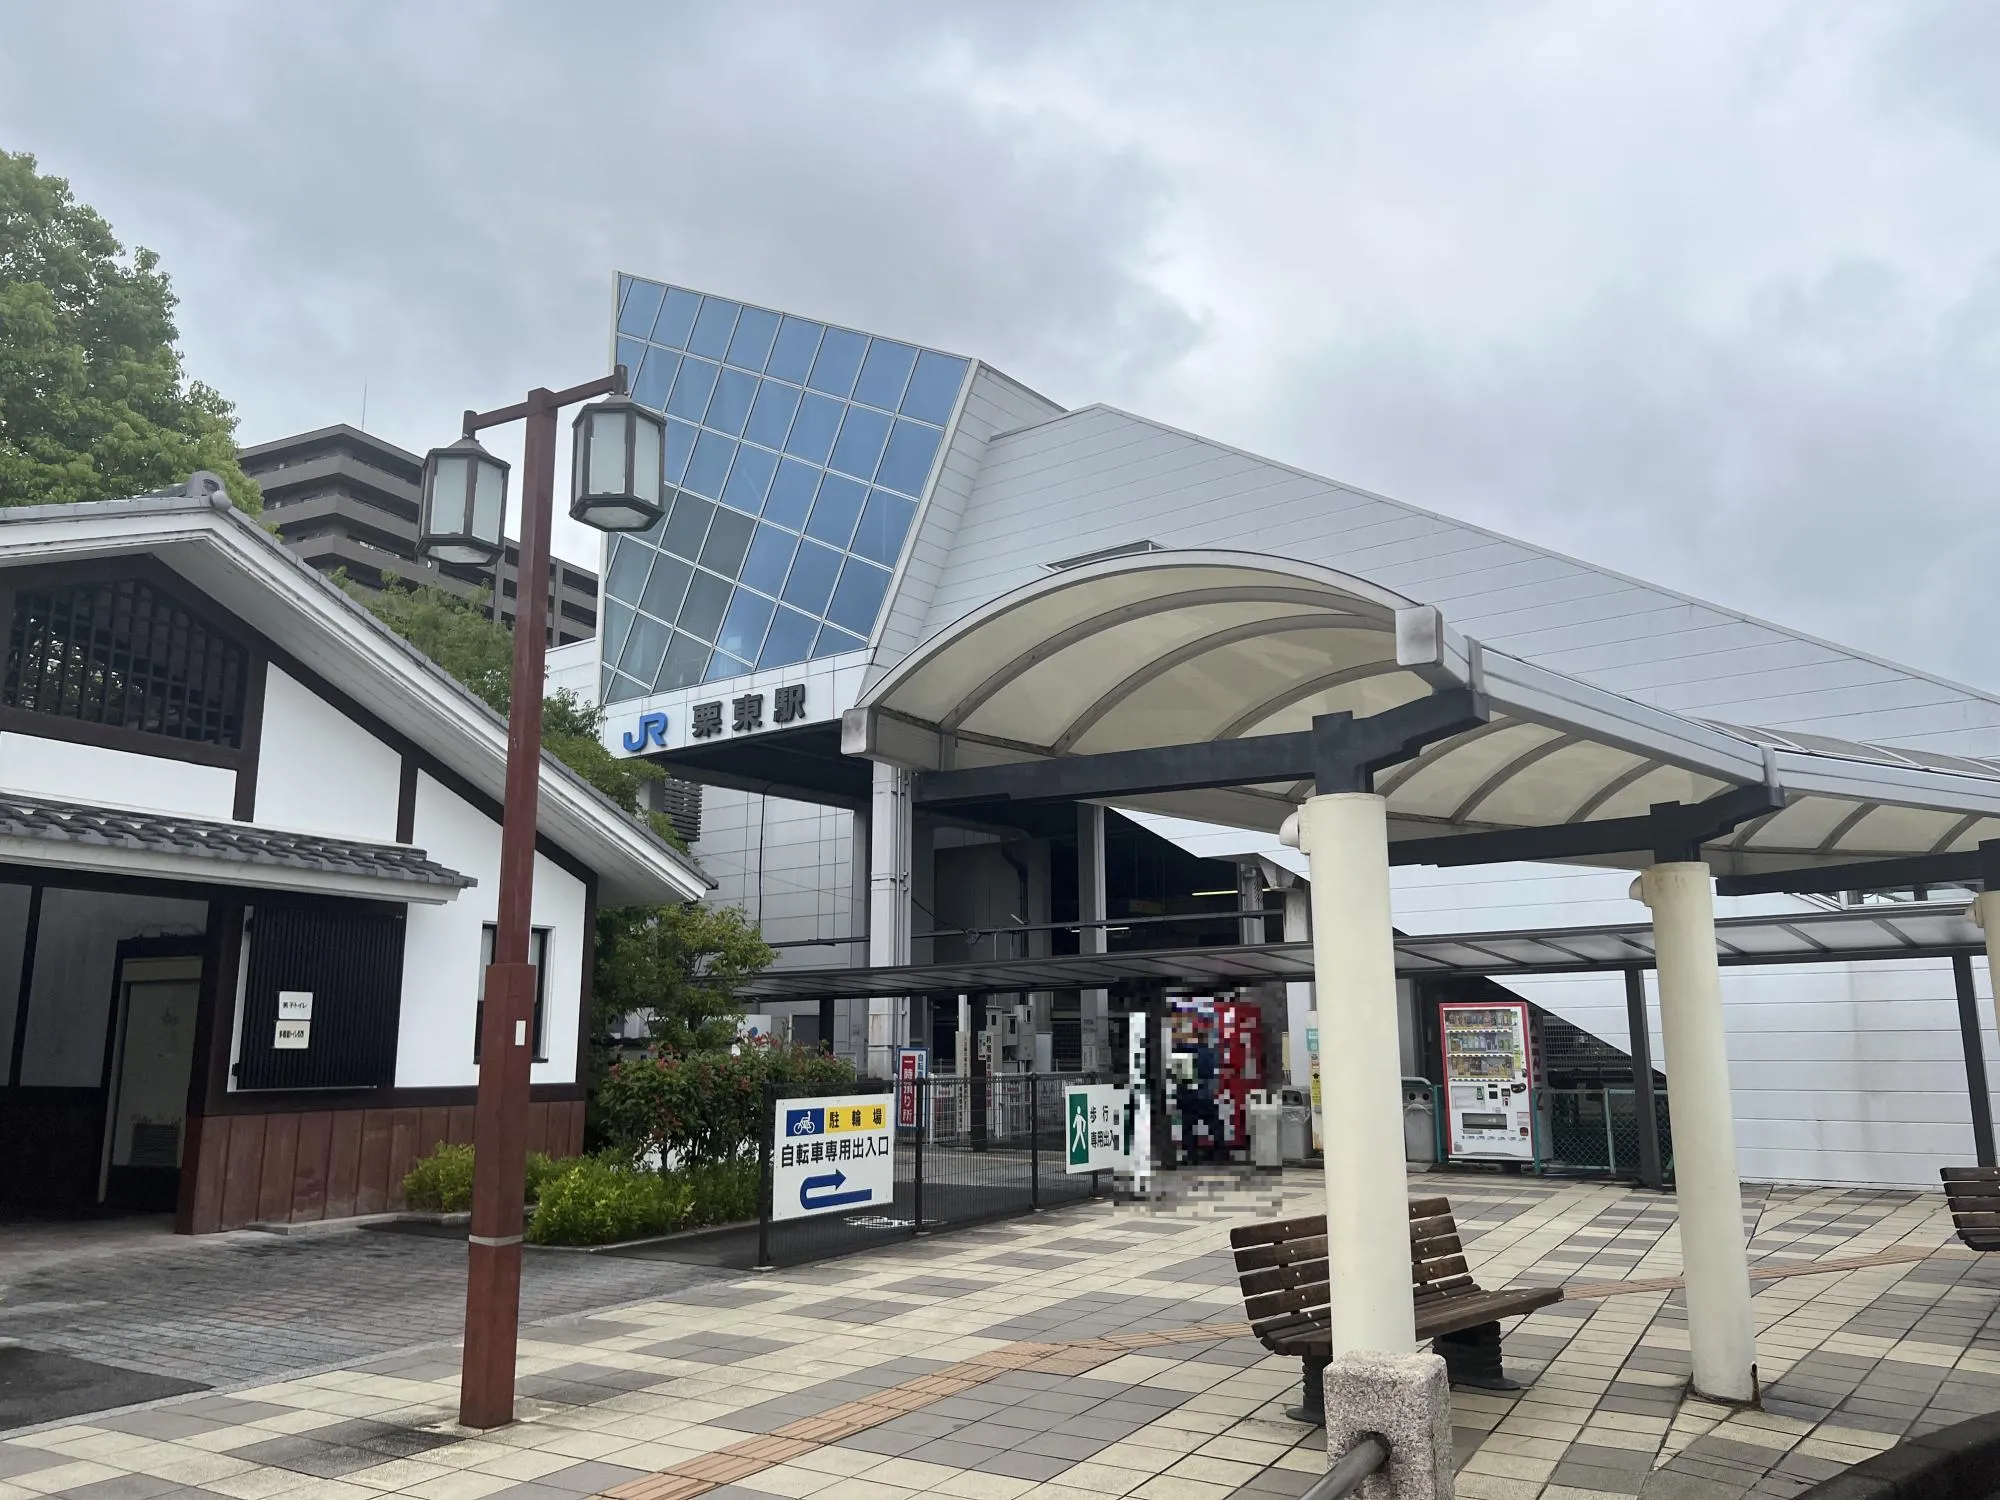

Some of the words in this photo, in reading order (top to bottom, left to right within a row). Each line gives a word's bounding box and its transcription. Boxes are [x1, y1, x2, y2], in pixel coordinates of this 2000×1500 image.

[623, 711, 669, 752] JR
[691, 683, 806, 738] 栗東駅
[828, 1108, 883, 1129] 駐輪場
[1089, 1105, 1120, 1124] 歩行
[1090, 1130, 1120, 1151] 専用出入
[781, 1136, 889, 1168] 自転車専用出入口
